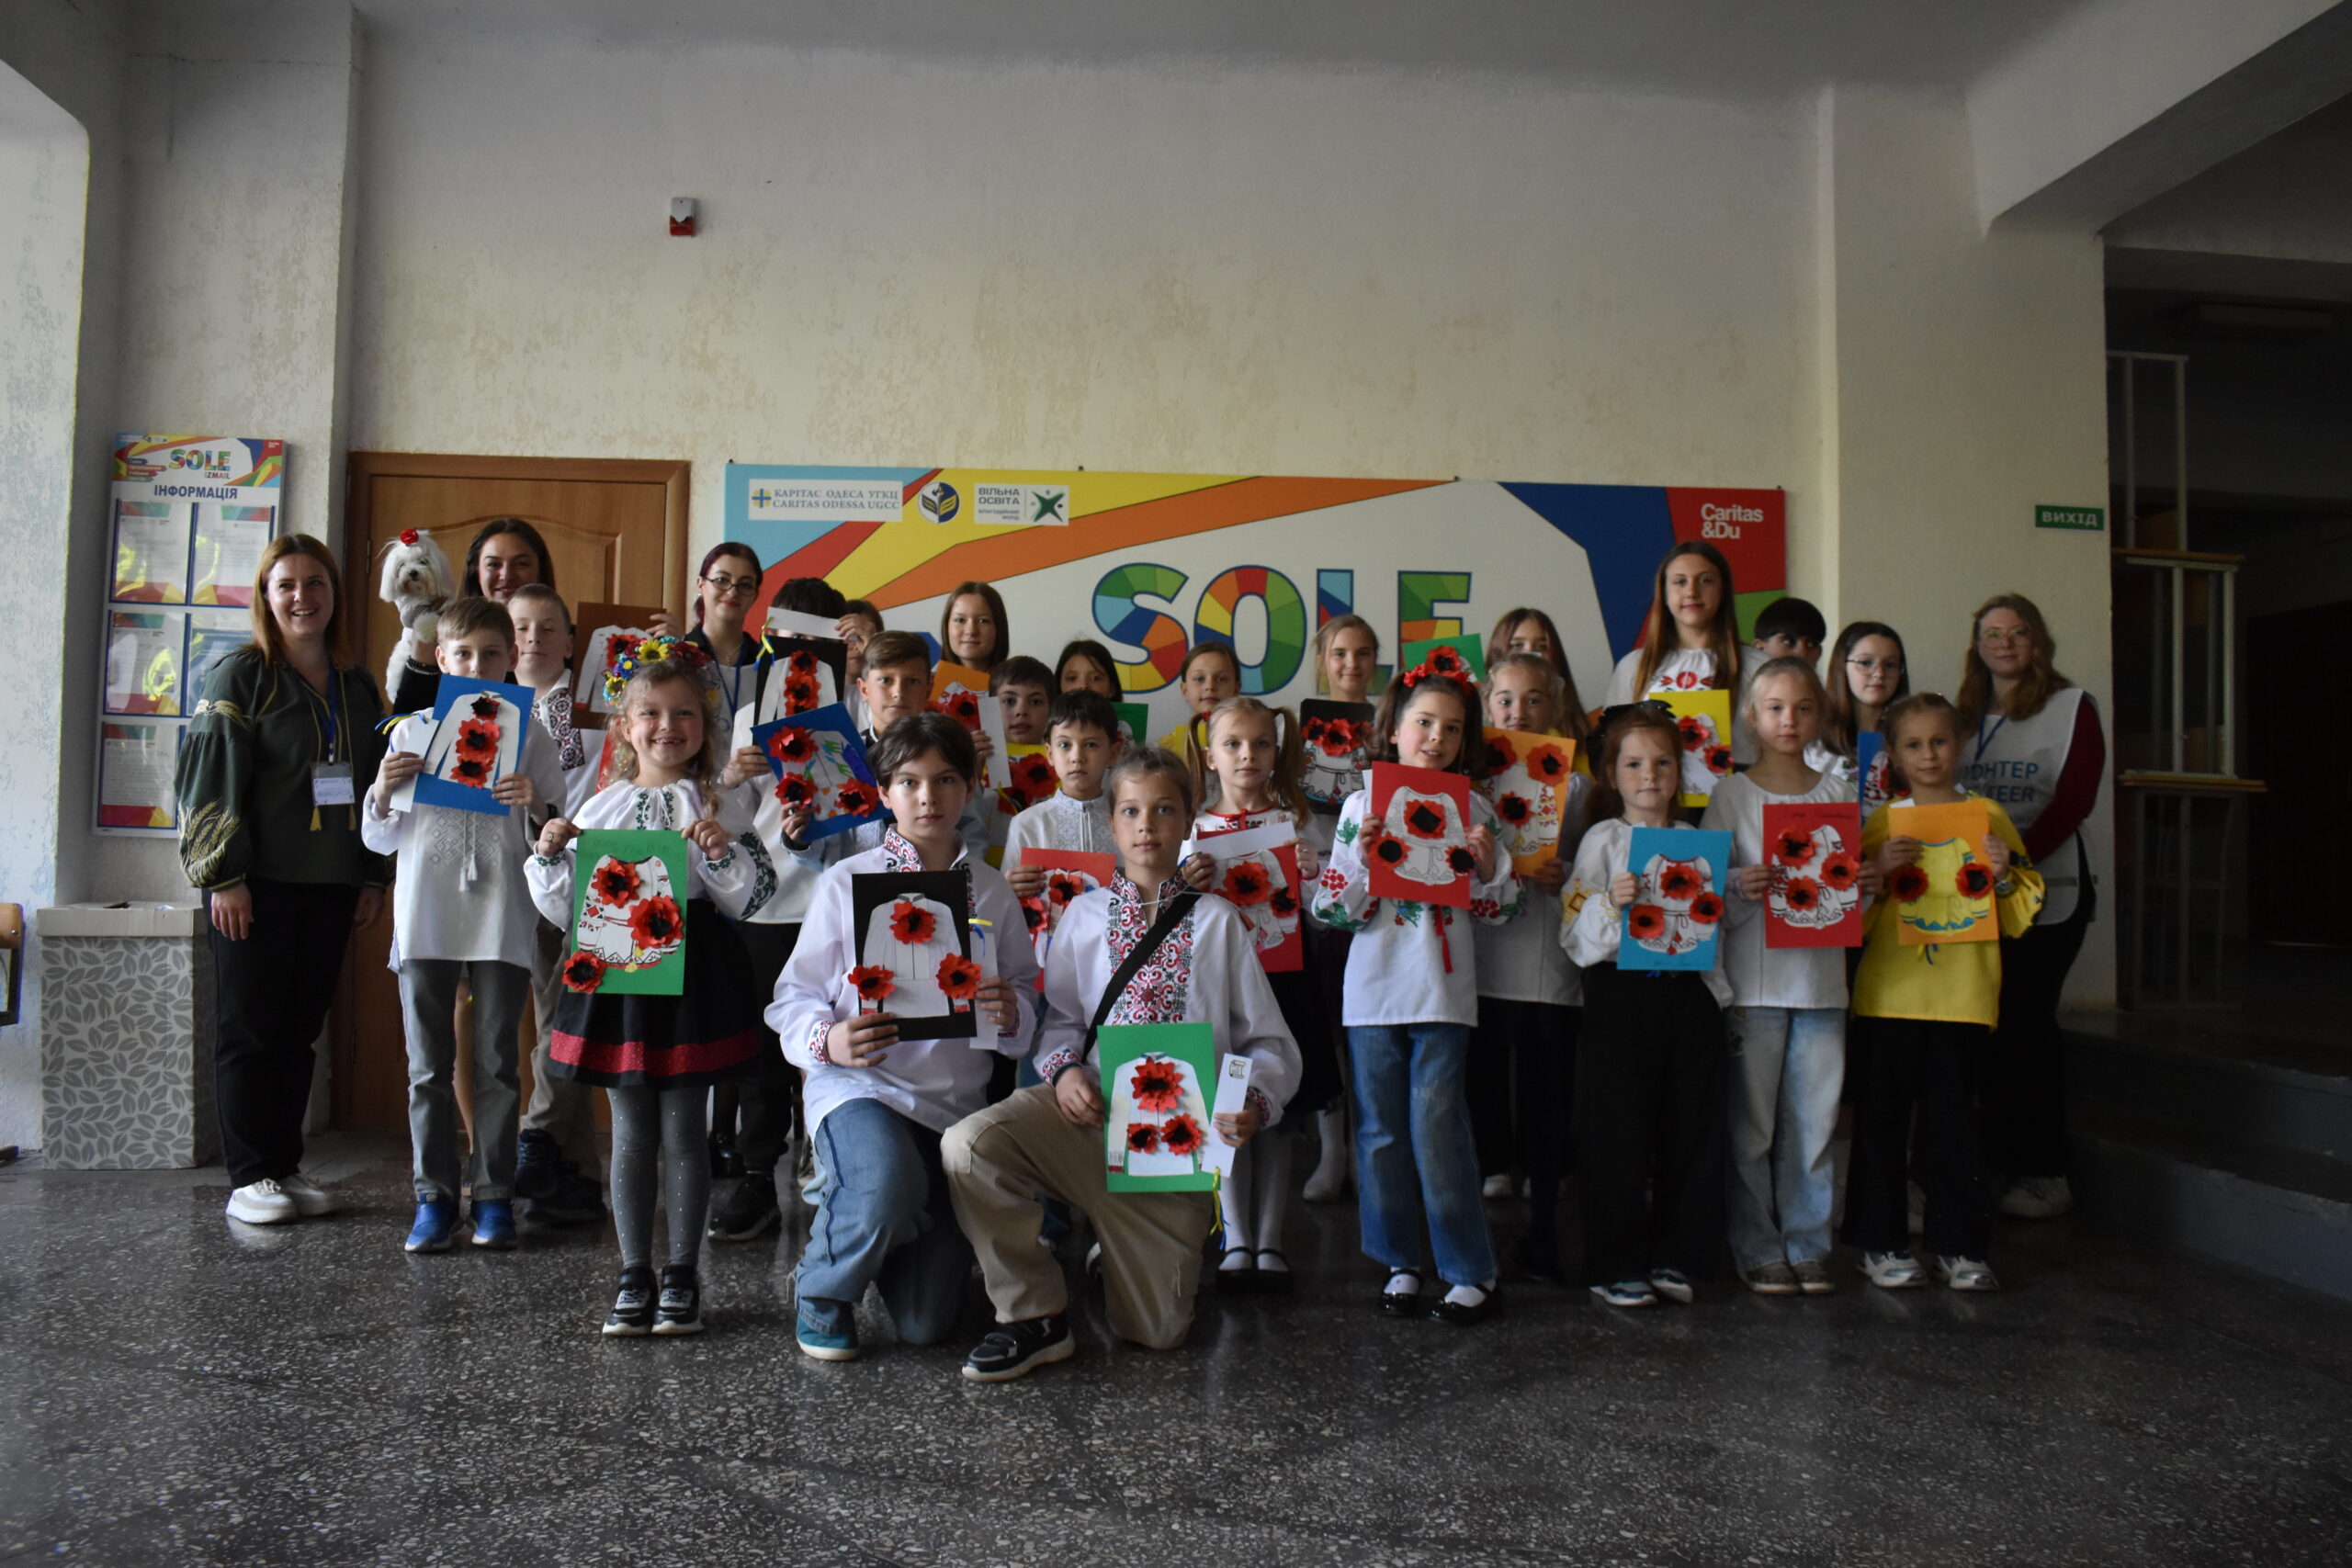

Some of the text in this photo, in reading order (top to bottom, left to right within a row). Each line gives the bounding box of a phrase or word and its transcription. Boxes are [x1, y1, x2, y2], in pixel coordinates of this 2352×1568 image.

[169, 448, 232, 471] SOLE
[204, 471, 230, 479] IZMAIL
[154, 485, 238, 501] ІНФОРМАЦІЯ
[775, 489, 821, 498] КАРІТАС
[826, 490, 864, 499] ОДЕСА
[978, 487, 1020, 496] ВІЛЬНА
[773, 500, 899, 509] CARITAS ODESSA UGCC
[978, 497, 1020, 505] ОСВІТА
[1701, 502, 1764, 523] Caritas
[2041, 511, 2098, 527] ВИХІД
[1701, 521, 1741, 539] &Du
